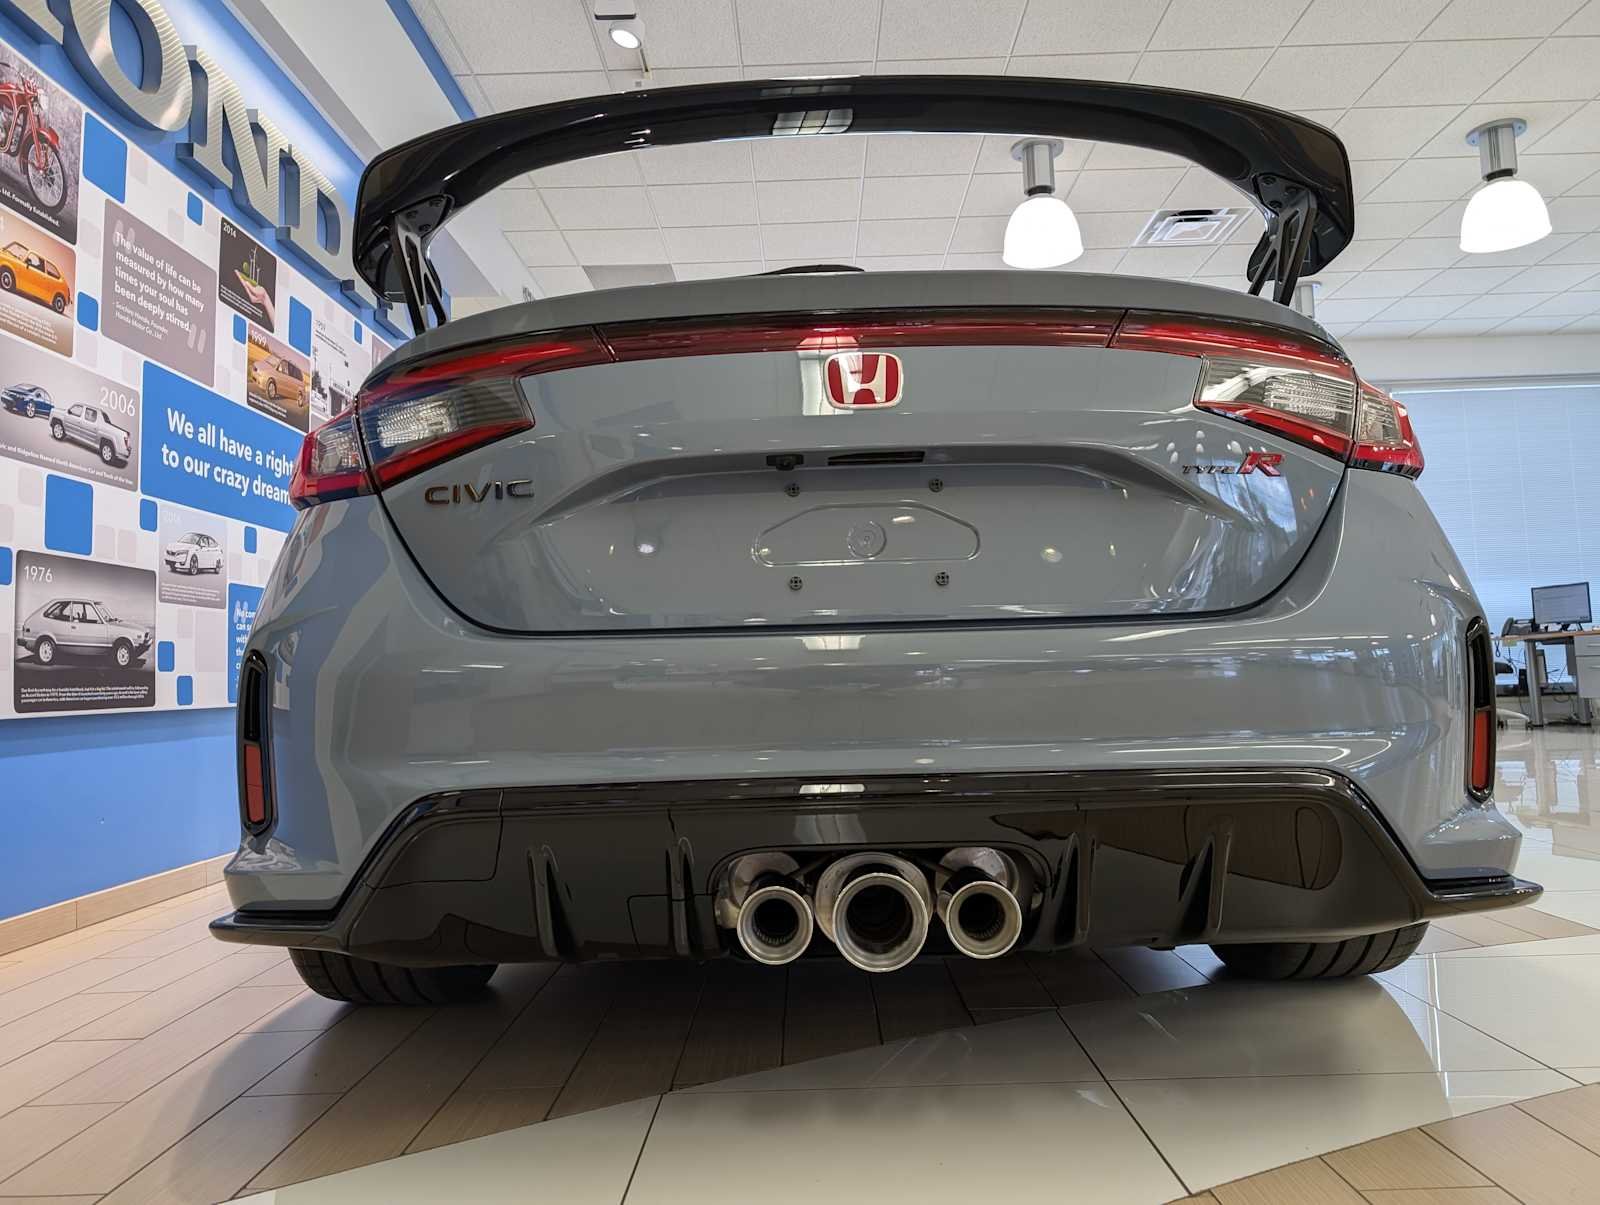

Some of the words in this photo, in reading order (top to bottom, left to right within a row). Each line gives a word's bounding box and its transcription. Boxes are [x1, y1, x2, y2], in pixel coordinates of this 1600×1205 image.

[223, 222, 237, 238] 2014
[115, 231, 131, 250] The
[133, 242, 154, 264] value
[156, 259, 165, 270] of
[165, 262, 177, 279] life
[178, 273, 191, 287] can
[191, 279, 201, 294] be
[115, 265, 138, 287] times
[139, 281, 158, 297] your
[159, 294, 175, 310] soul
[175, 300, 189, 315] has
[116, 251, 155, 281] measured
[156, 272, 167, 289] by
[168, 279, 184, 298] how
[185, 293, 204, 313] many
[115, 281, 136, 302] been
[137, 295, 165, 320] deeply
[165, 311, 192, 332] stirred.
[115, 311, 131, 324] Honda
[131, 320, 146, 331] Motor
[251, 330, 267, 345] 1999
[100, 387, 136, 417] 2006
[168, 408, 194, 439] We
[198, 423, 216, 449] all
[220, 428, 252, 462] have
[255, 449, 263, 466] a
[265, 450, 293, 478] right
[162, 443, 179, 468] to
[184, 455, 211, 479] our
[213, 465, 250, 497] crazy
[1182, 464, 1236, 475] TYPE
[1237, 451, 1286, 477] R
[425, 479, 535, 505] CIVIC
[24, 565, 53, 583] 1976
